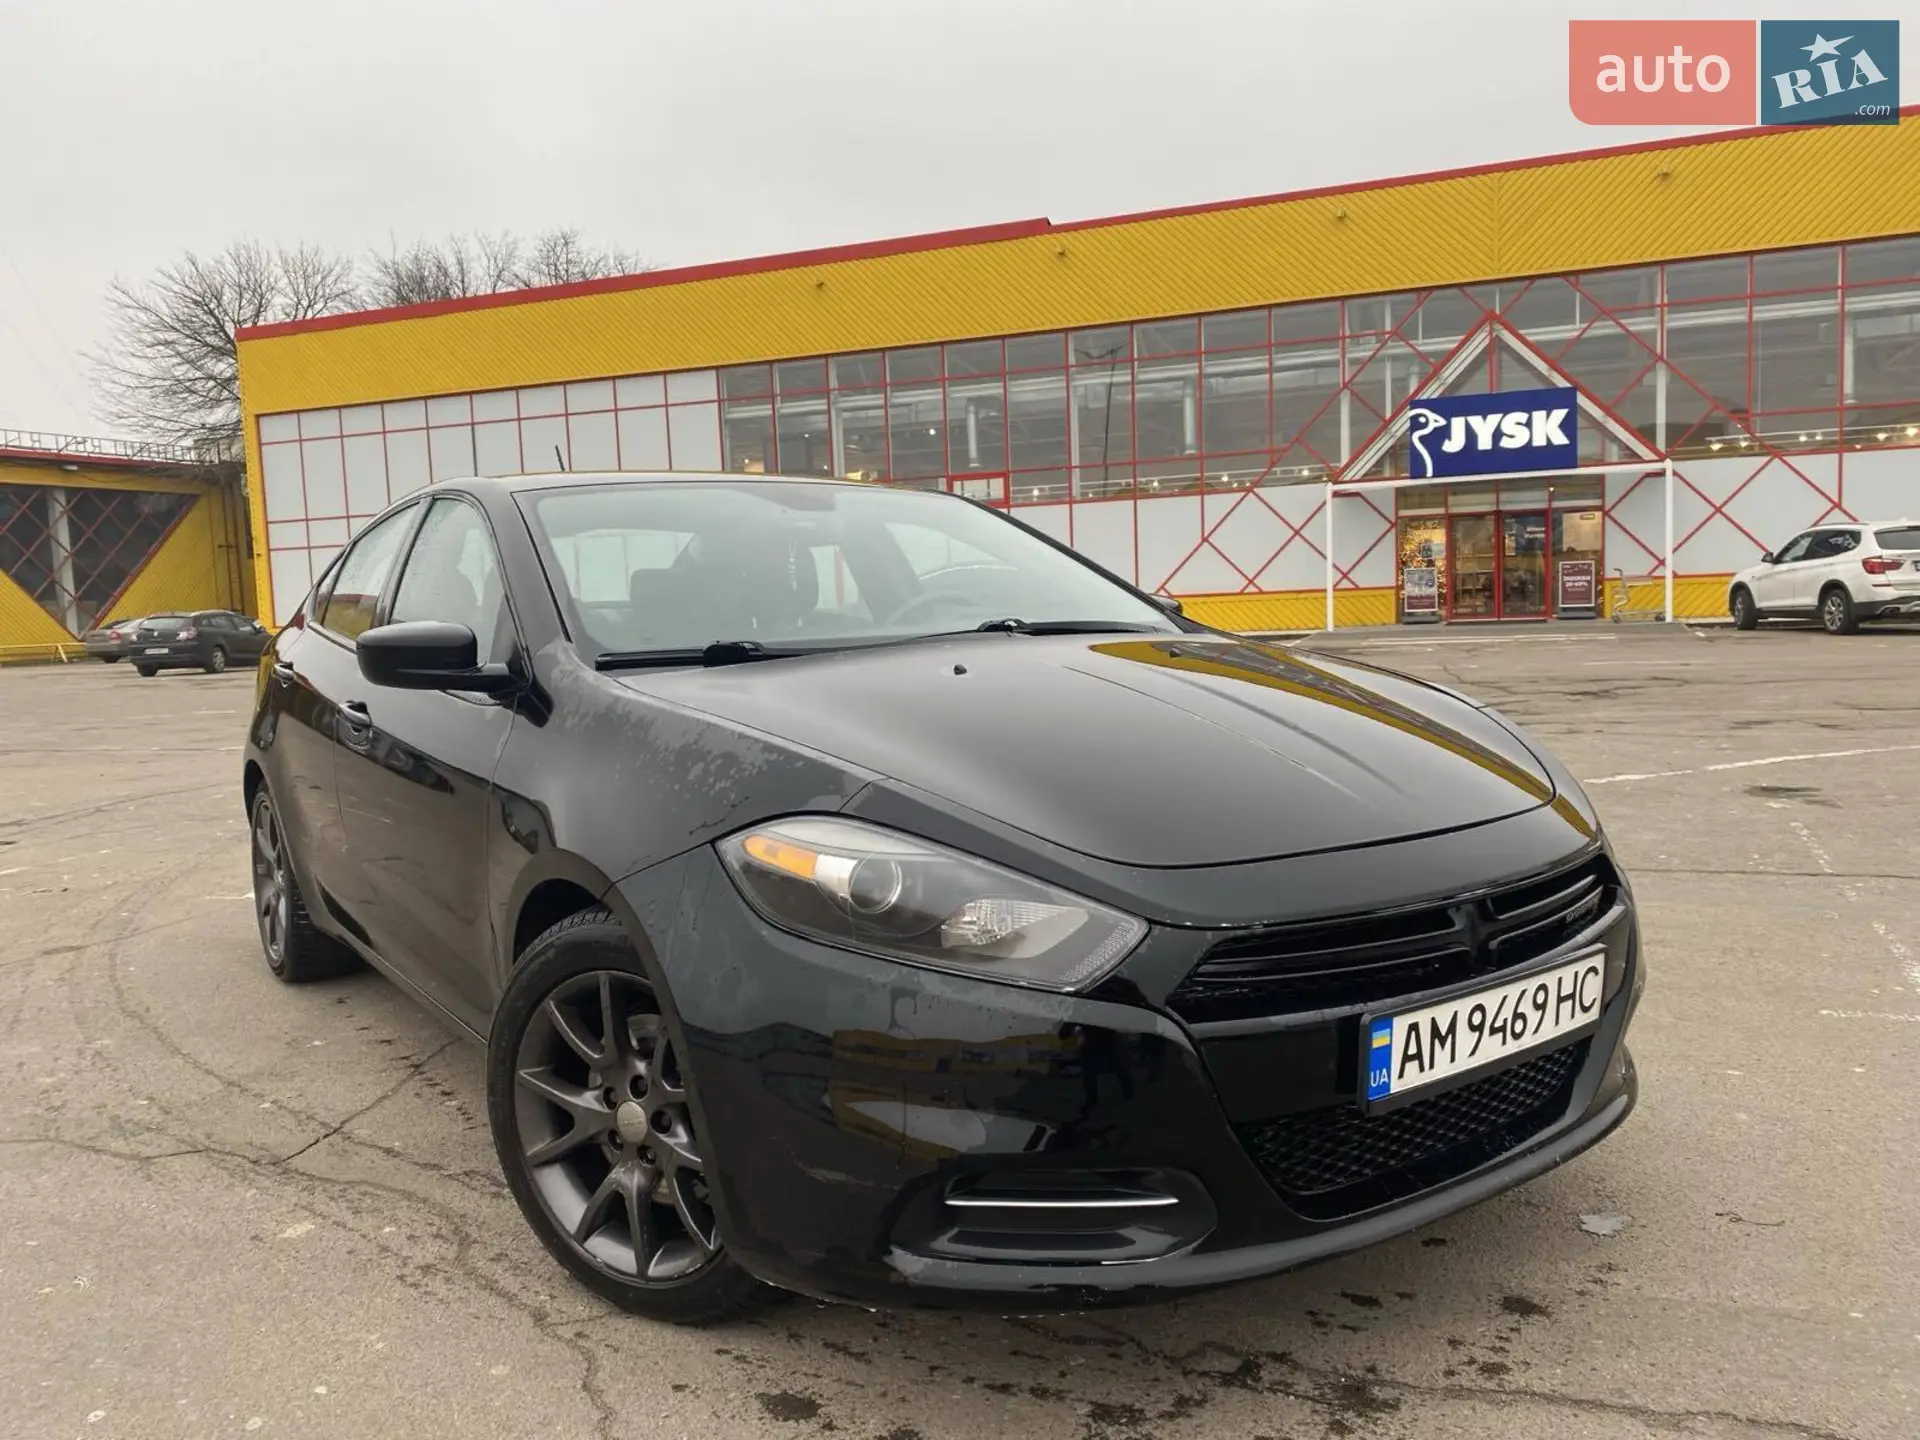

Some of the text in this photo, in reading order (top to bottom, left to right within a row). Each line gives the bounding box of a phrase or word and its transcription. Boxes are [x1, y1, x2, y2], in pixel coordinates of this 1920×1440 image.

[1442, 409, 1570, 453] JYSK
[1397, 966, 1600, 1080] AM 9469 HC
[1371, 1068, 1388, 1087] UA
